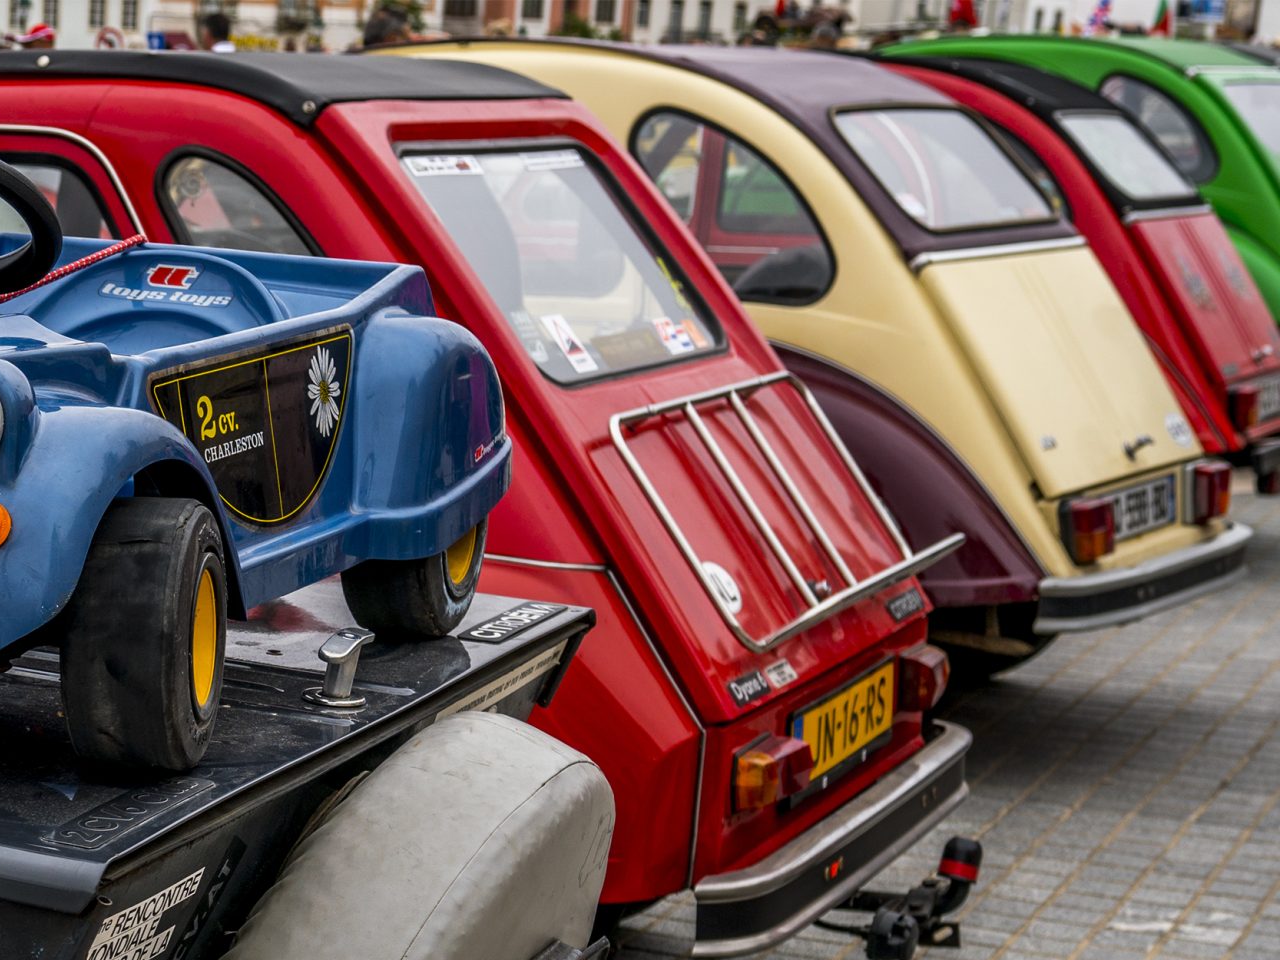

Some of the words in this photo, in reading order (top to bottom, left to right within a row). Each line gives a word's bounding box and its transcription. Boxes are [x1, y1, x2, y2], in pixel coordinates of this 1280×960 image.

[101, 283, 167, 300] toys
[169, 292, 231, 306] toys
[204, 430, 265, 464] CHARLESTON
[110, 871, 202, 937] RENCONTRE
[148, 930, 171, 958] LA
